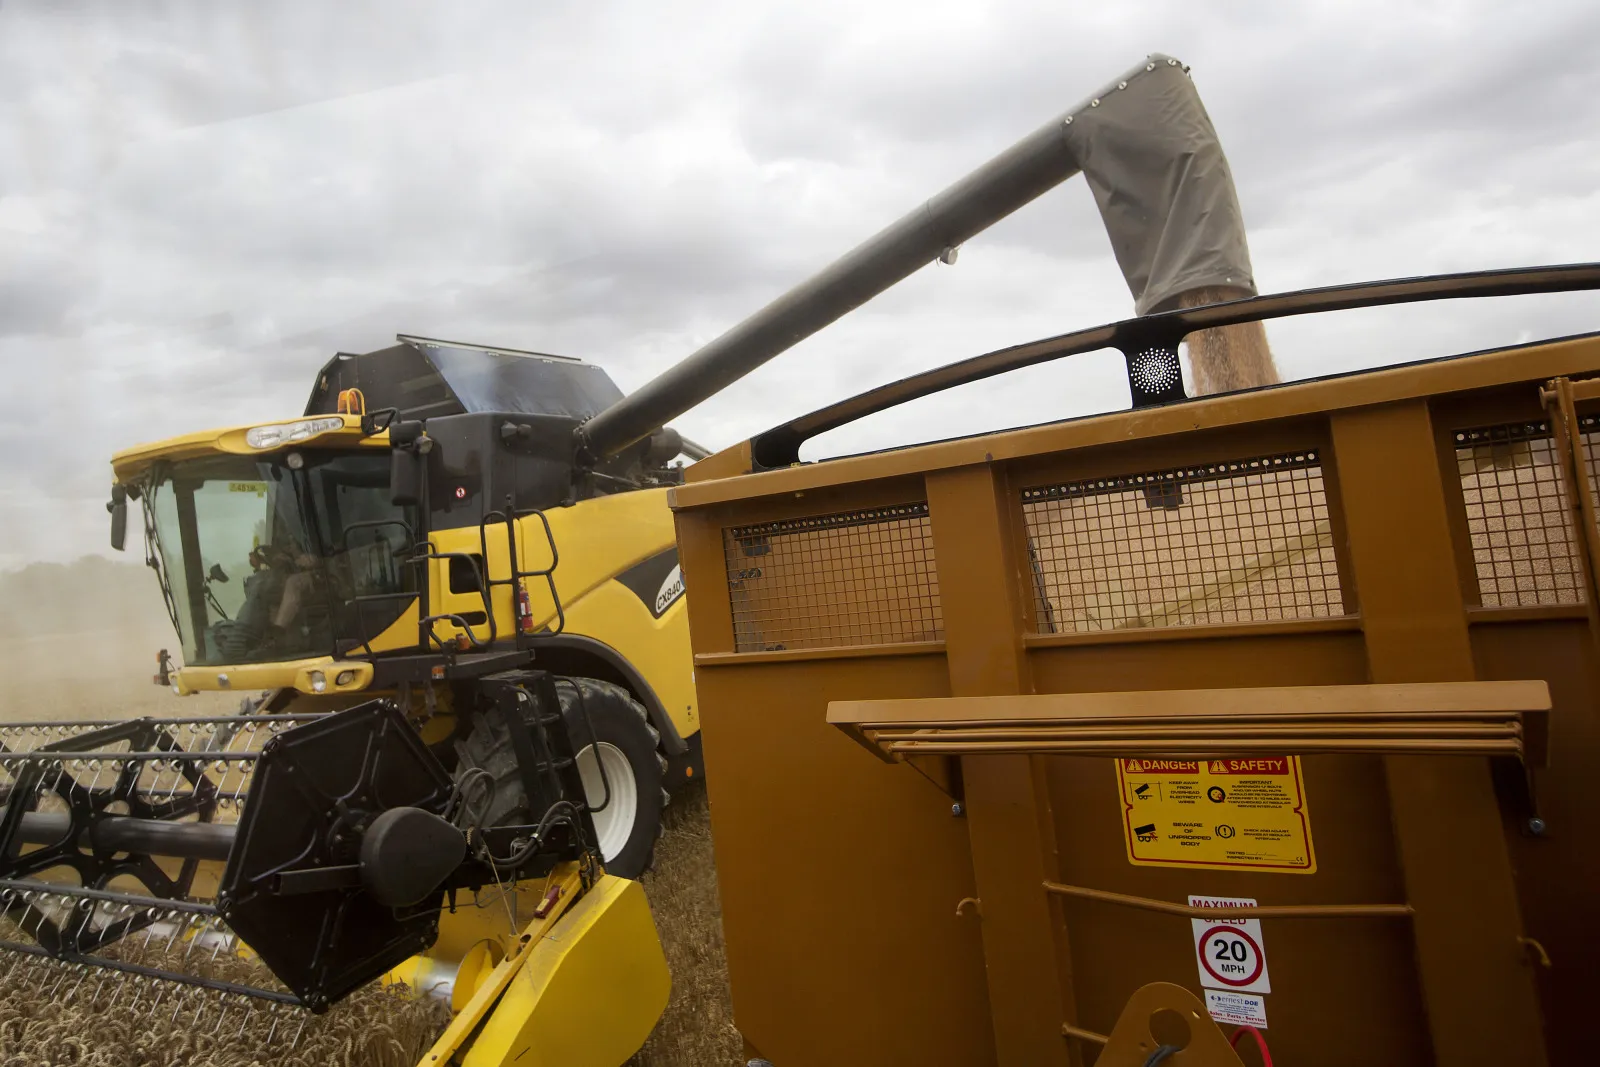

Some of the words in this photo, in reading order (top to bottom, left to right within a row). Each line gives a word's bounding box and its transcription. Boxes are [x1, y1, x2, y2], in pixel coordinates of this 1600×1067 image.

[658, 580, 680, 610] CX840
[1142, 760, 1196, 770] DANGER
[1230, 760, 1282, 770] SAFETY
[1214, 939, 1247, 962] 20
[1222, 964, 1245, 973] MPH
